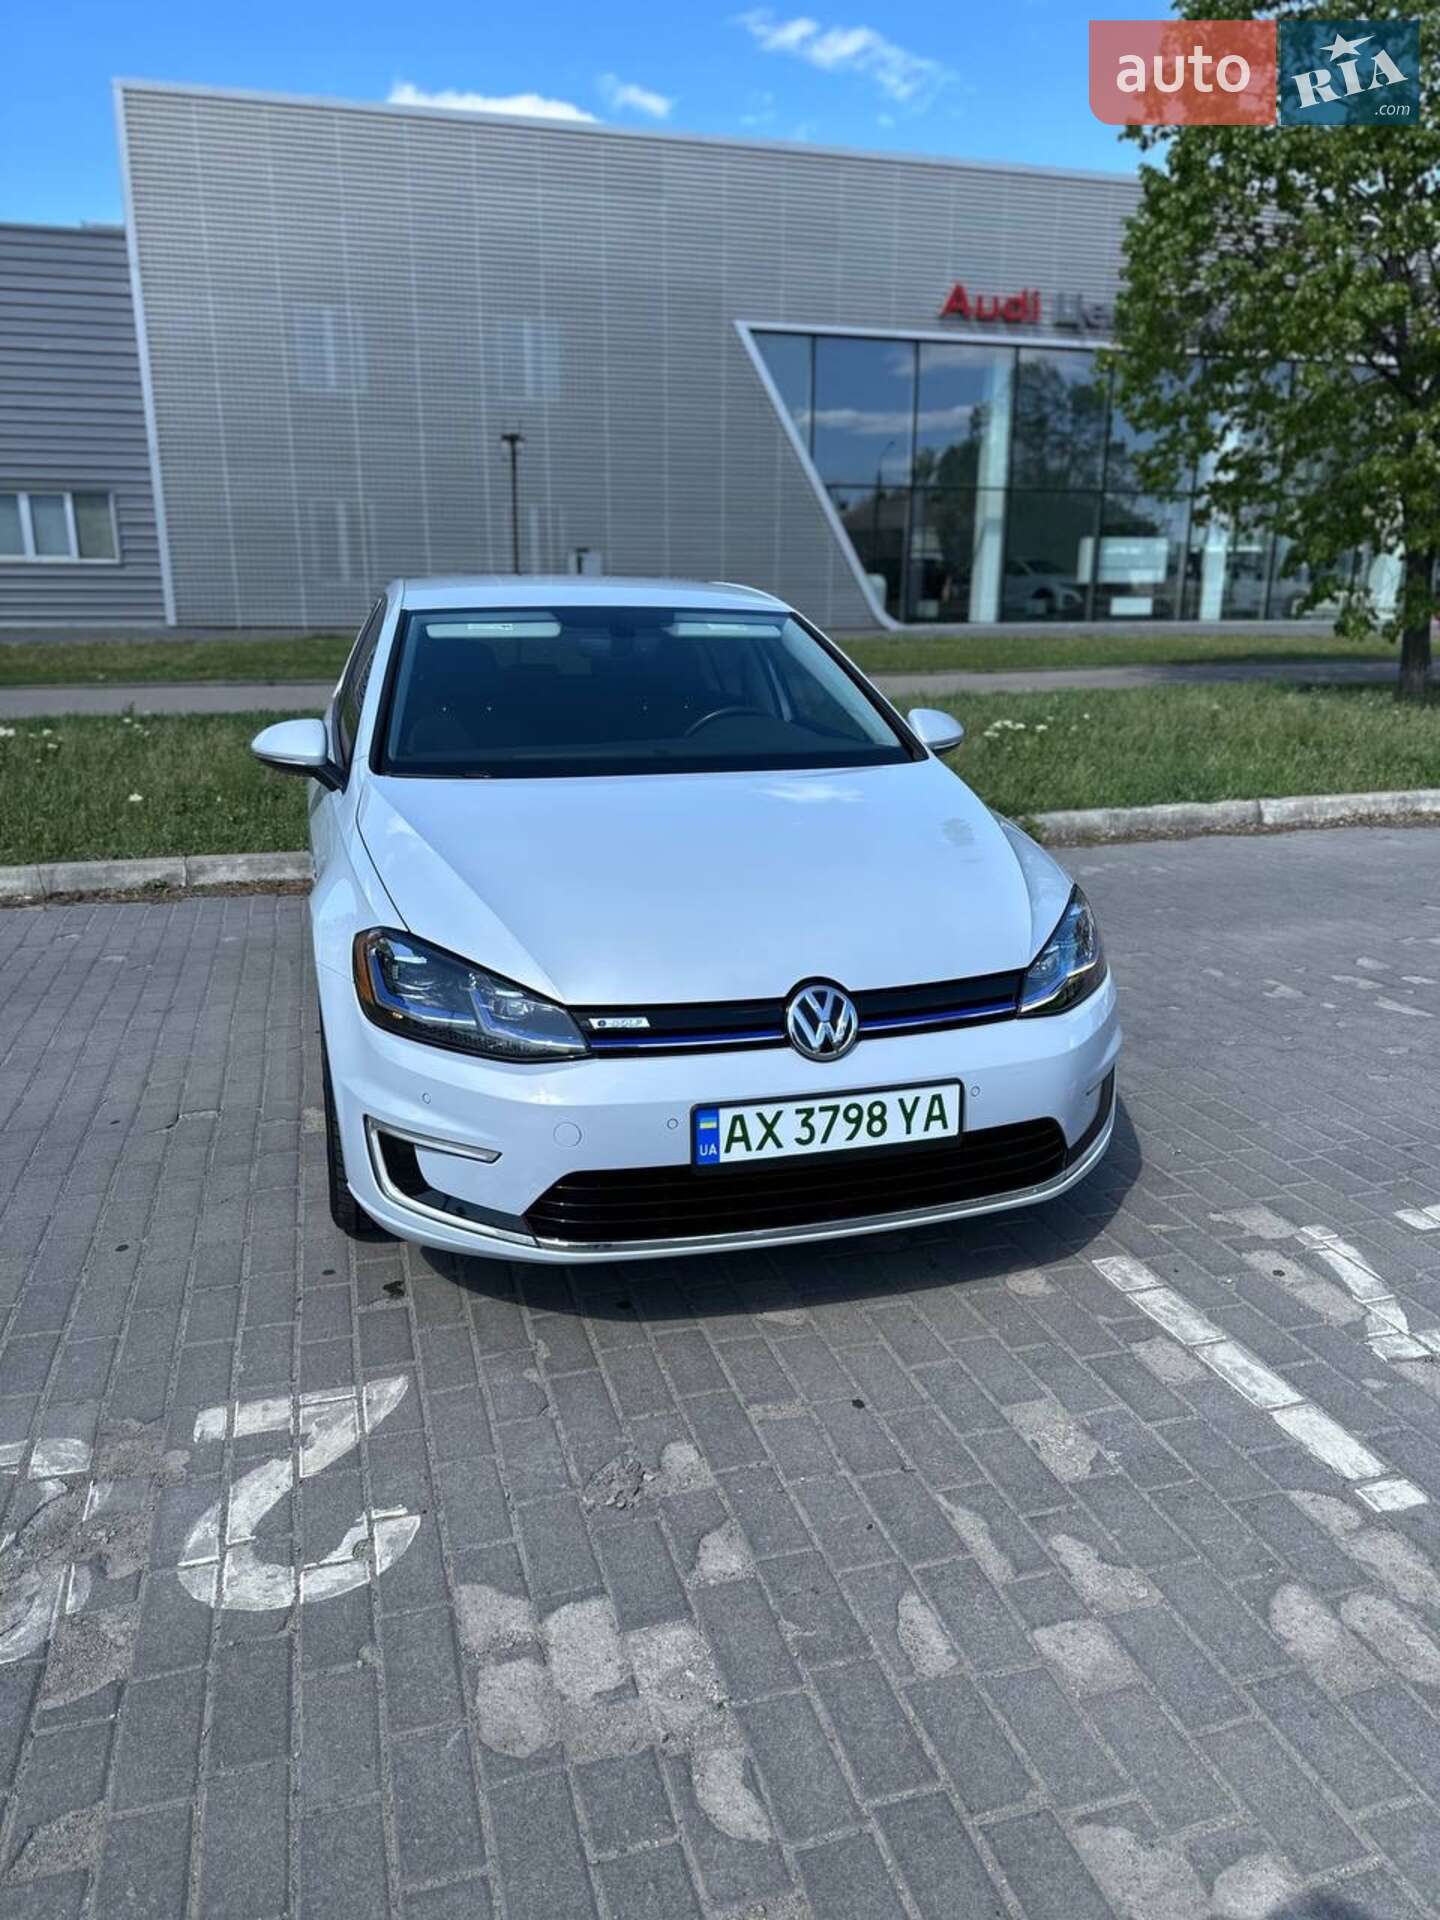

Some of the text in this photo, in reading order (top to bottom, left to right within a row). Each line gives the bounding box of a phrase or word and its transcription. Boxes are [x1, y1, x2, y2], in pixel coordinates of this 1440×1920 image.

[939, 281, 1040, 324] Audi
[724, 1093, 949, 1154] AX 3798 YA
[699, 1143, 718, 1156] UA
